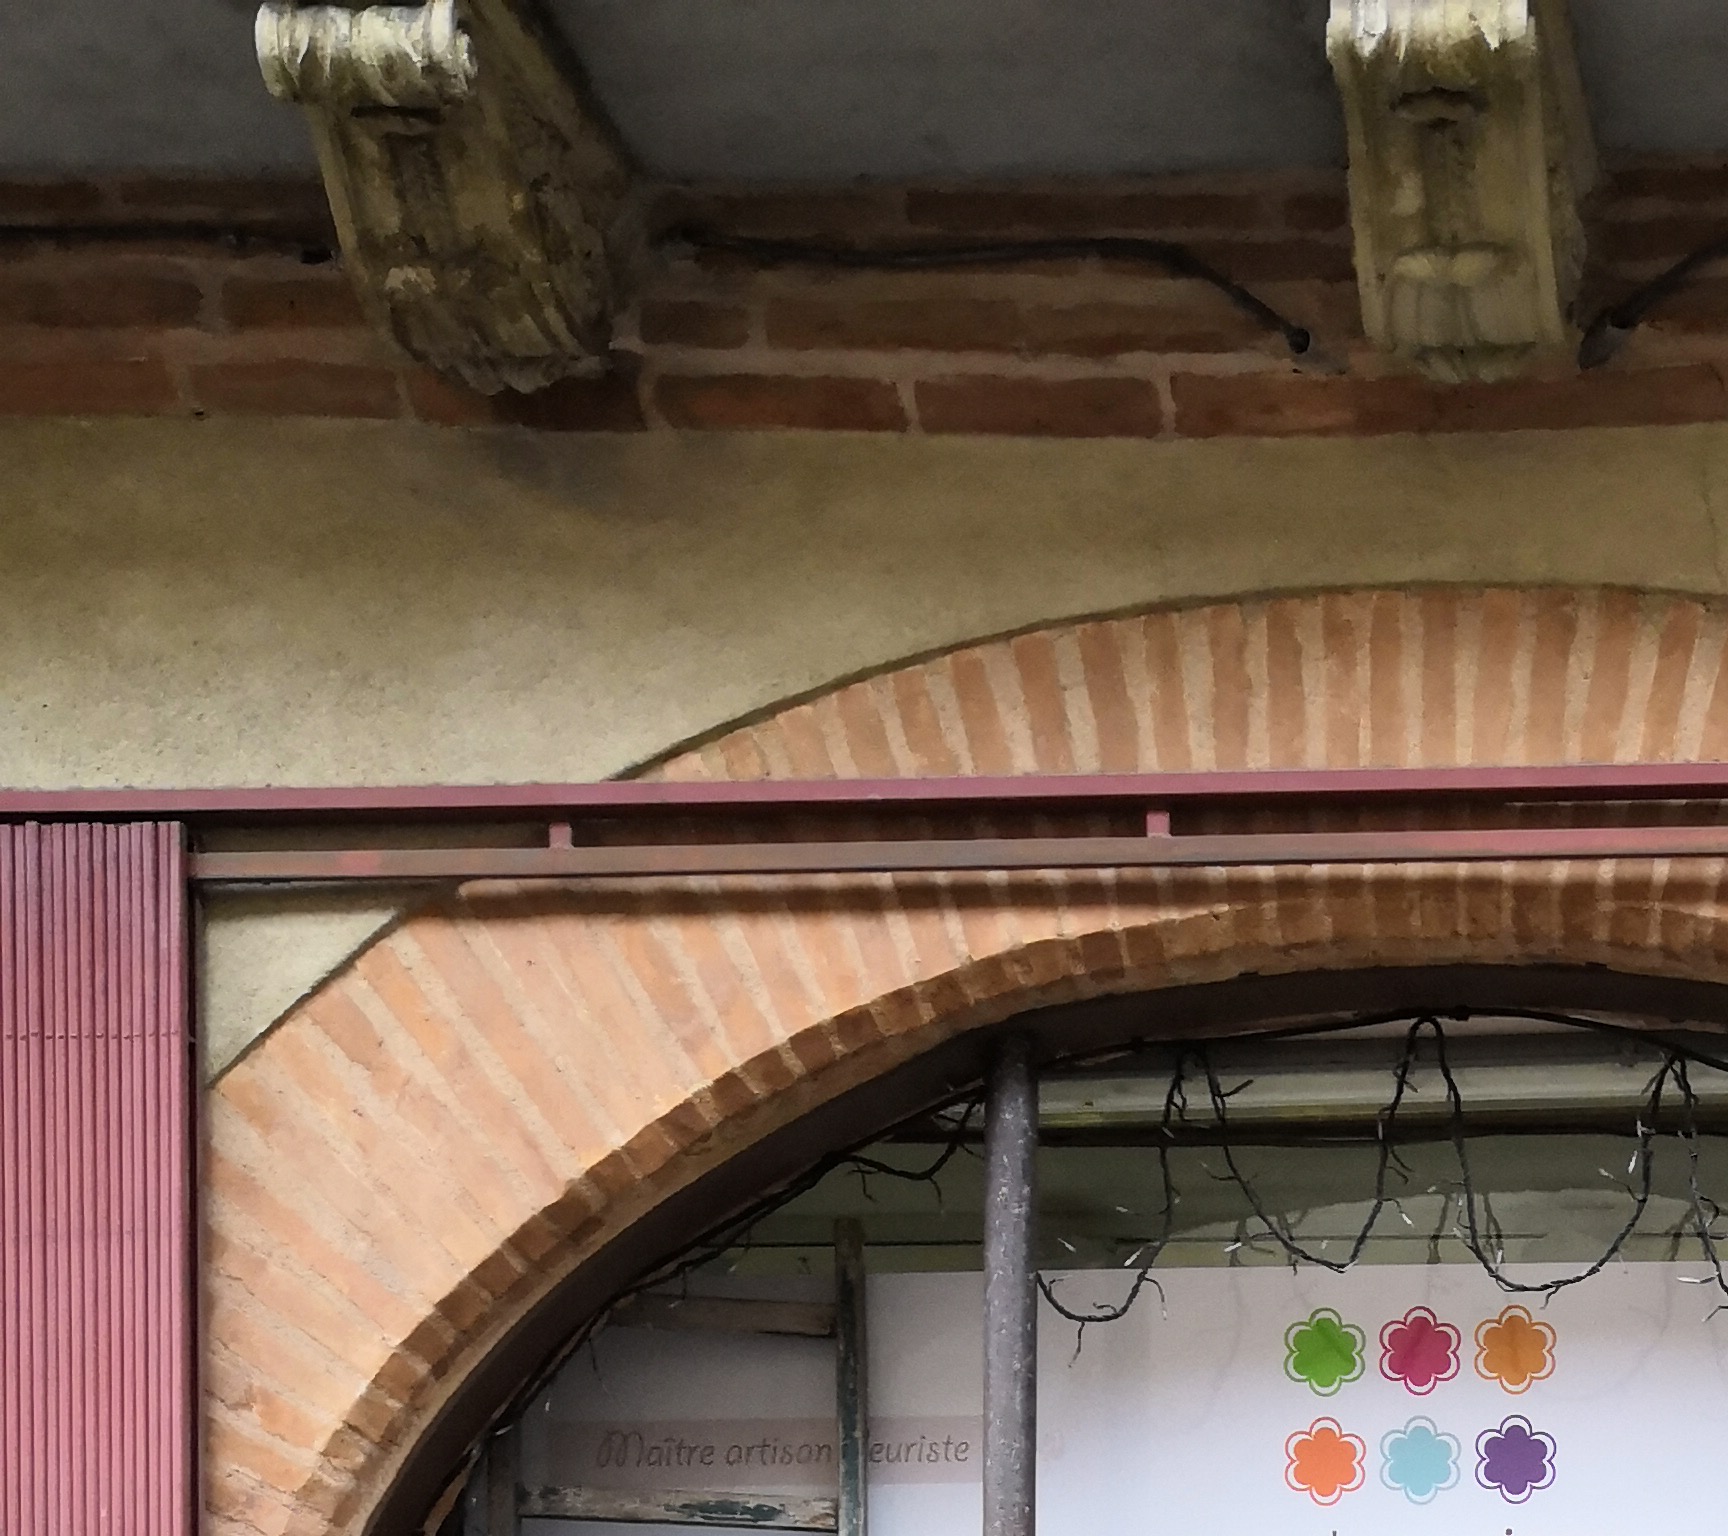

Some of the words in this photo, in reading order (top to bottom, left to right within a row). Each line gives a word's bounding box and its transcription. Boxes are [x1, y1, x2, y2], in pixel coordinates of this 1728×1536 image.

[597, 1430, 715, 1467] Maître
[725, 1438, 832, 1466] artisan
[866, 1434, 970, 1463] euriste
